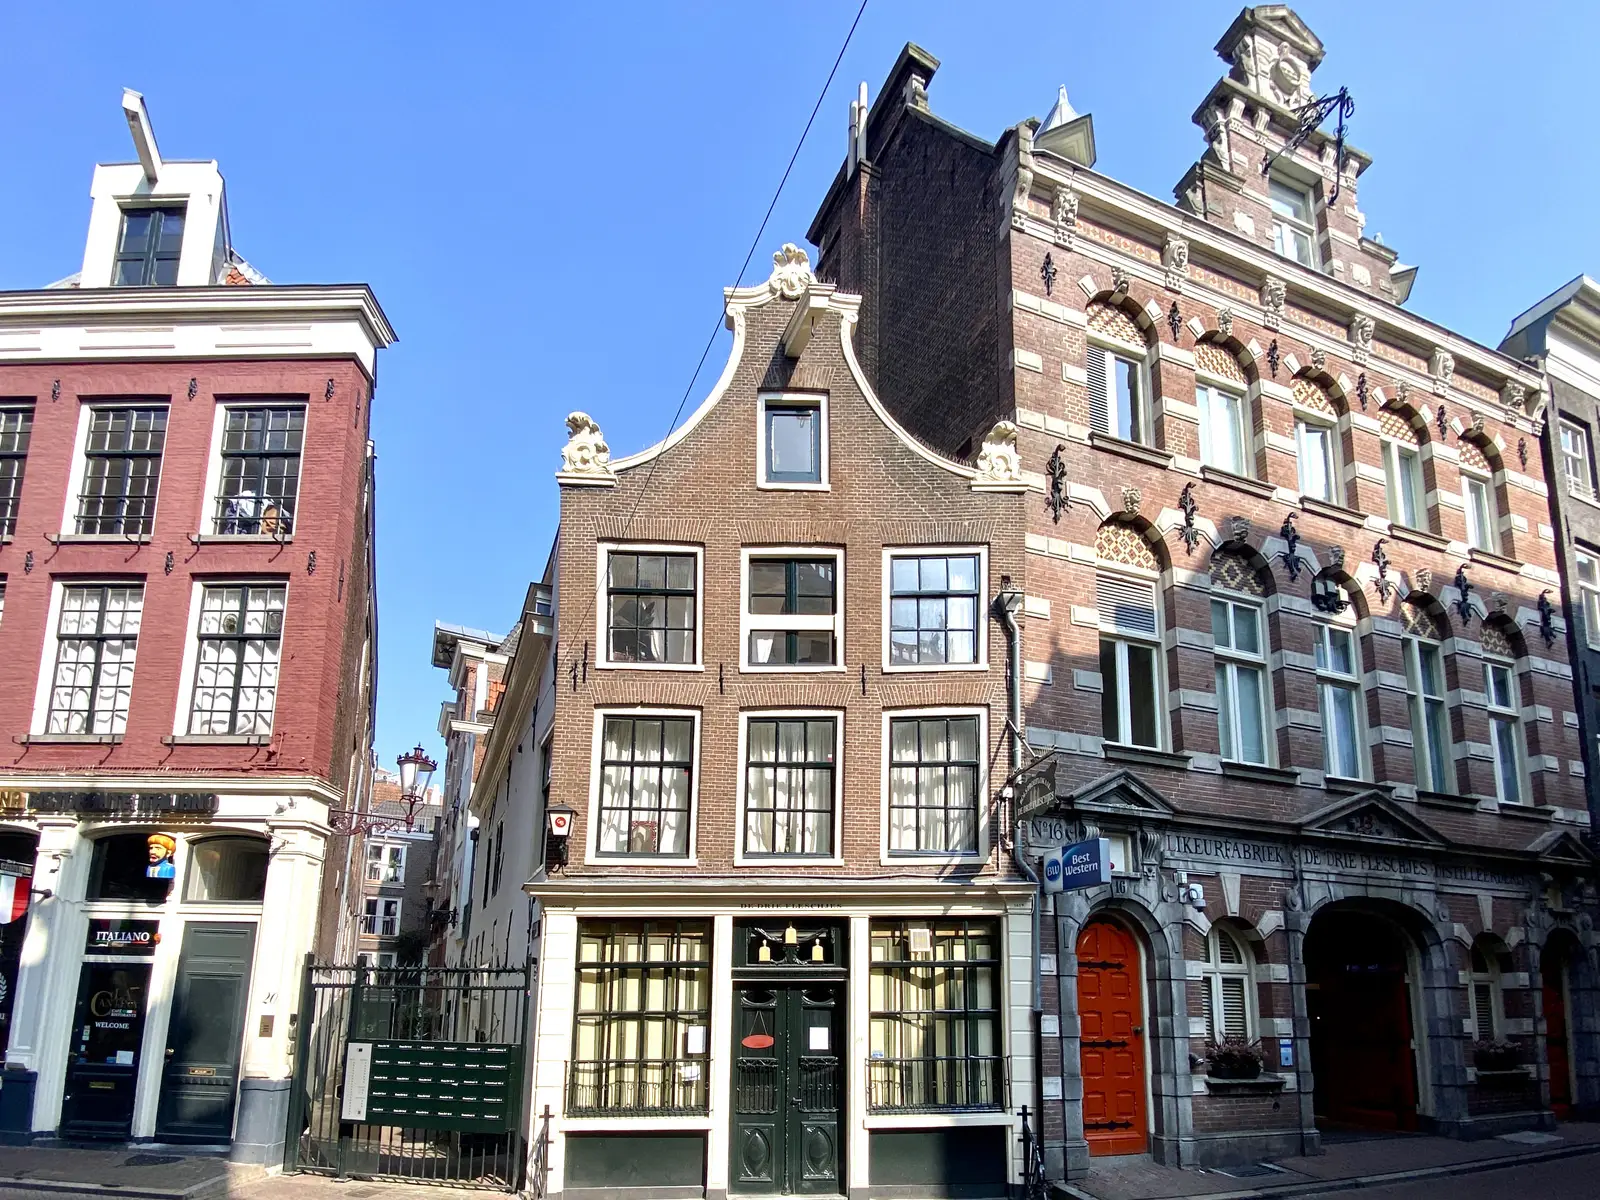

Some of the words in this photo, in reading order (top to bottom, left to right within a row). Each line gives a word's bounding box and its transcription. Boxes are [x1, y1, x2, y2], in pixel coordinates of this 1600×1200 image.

[1072, 852, 1090, 865] Best
[1166, 835, 1285, 863] LIKEURFABRIEK
[1303, 848, 1321, 865] DE
[1326, 850, 1358, 869] DRIE
[1360, 854, 1428, 876] FLESCHJES
[1064, 861, 1098, 876] Western
[1115, 880, 1126, 894] 16
[95, 931, 150, 942] ITALIANO
[262, 992, 279, 1005] 20
[95, 1021, 130, 1030] WELCOME
